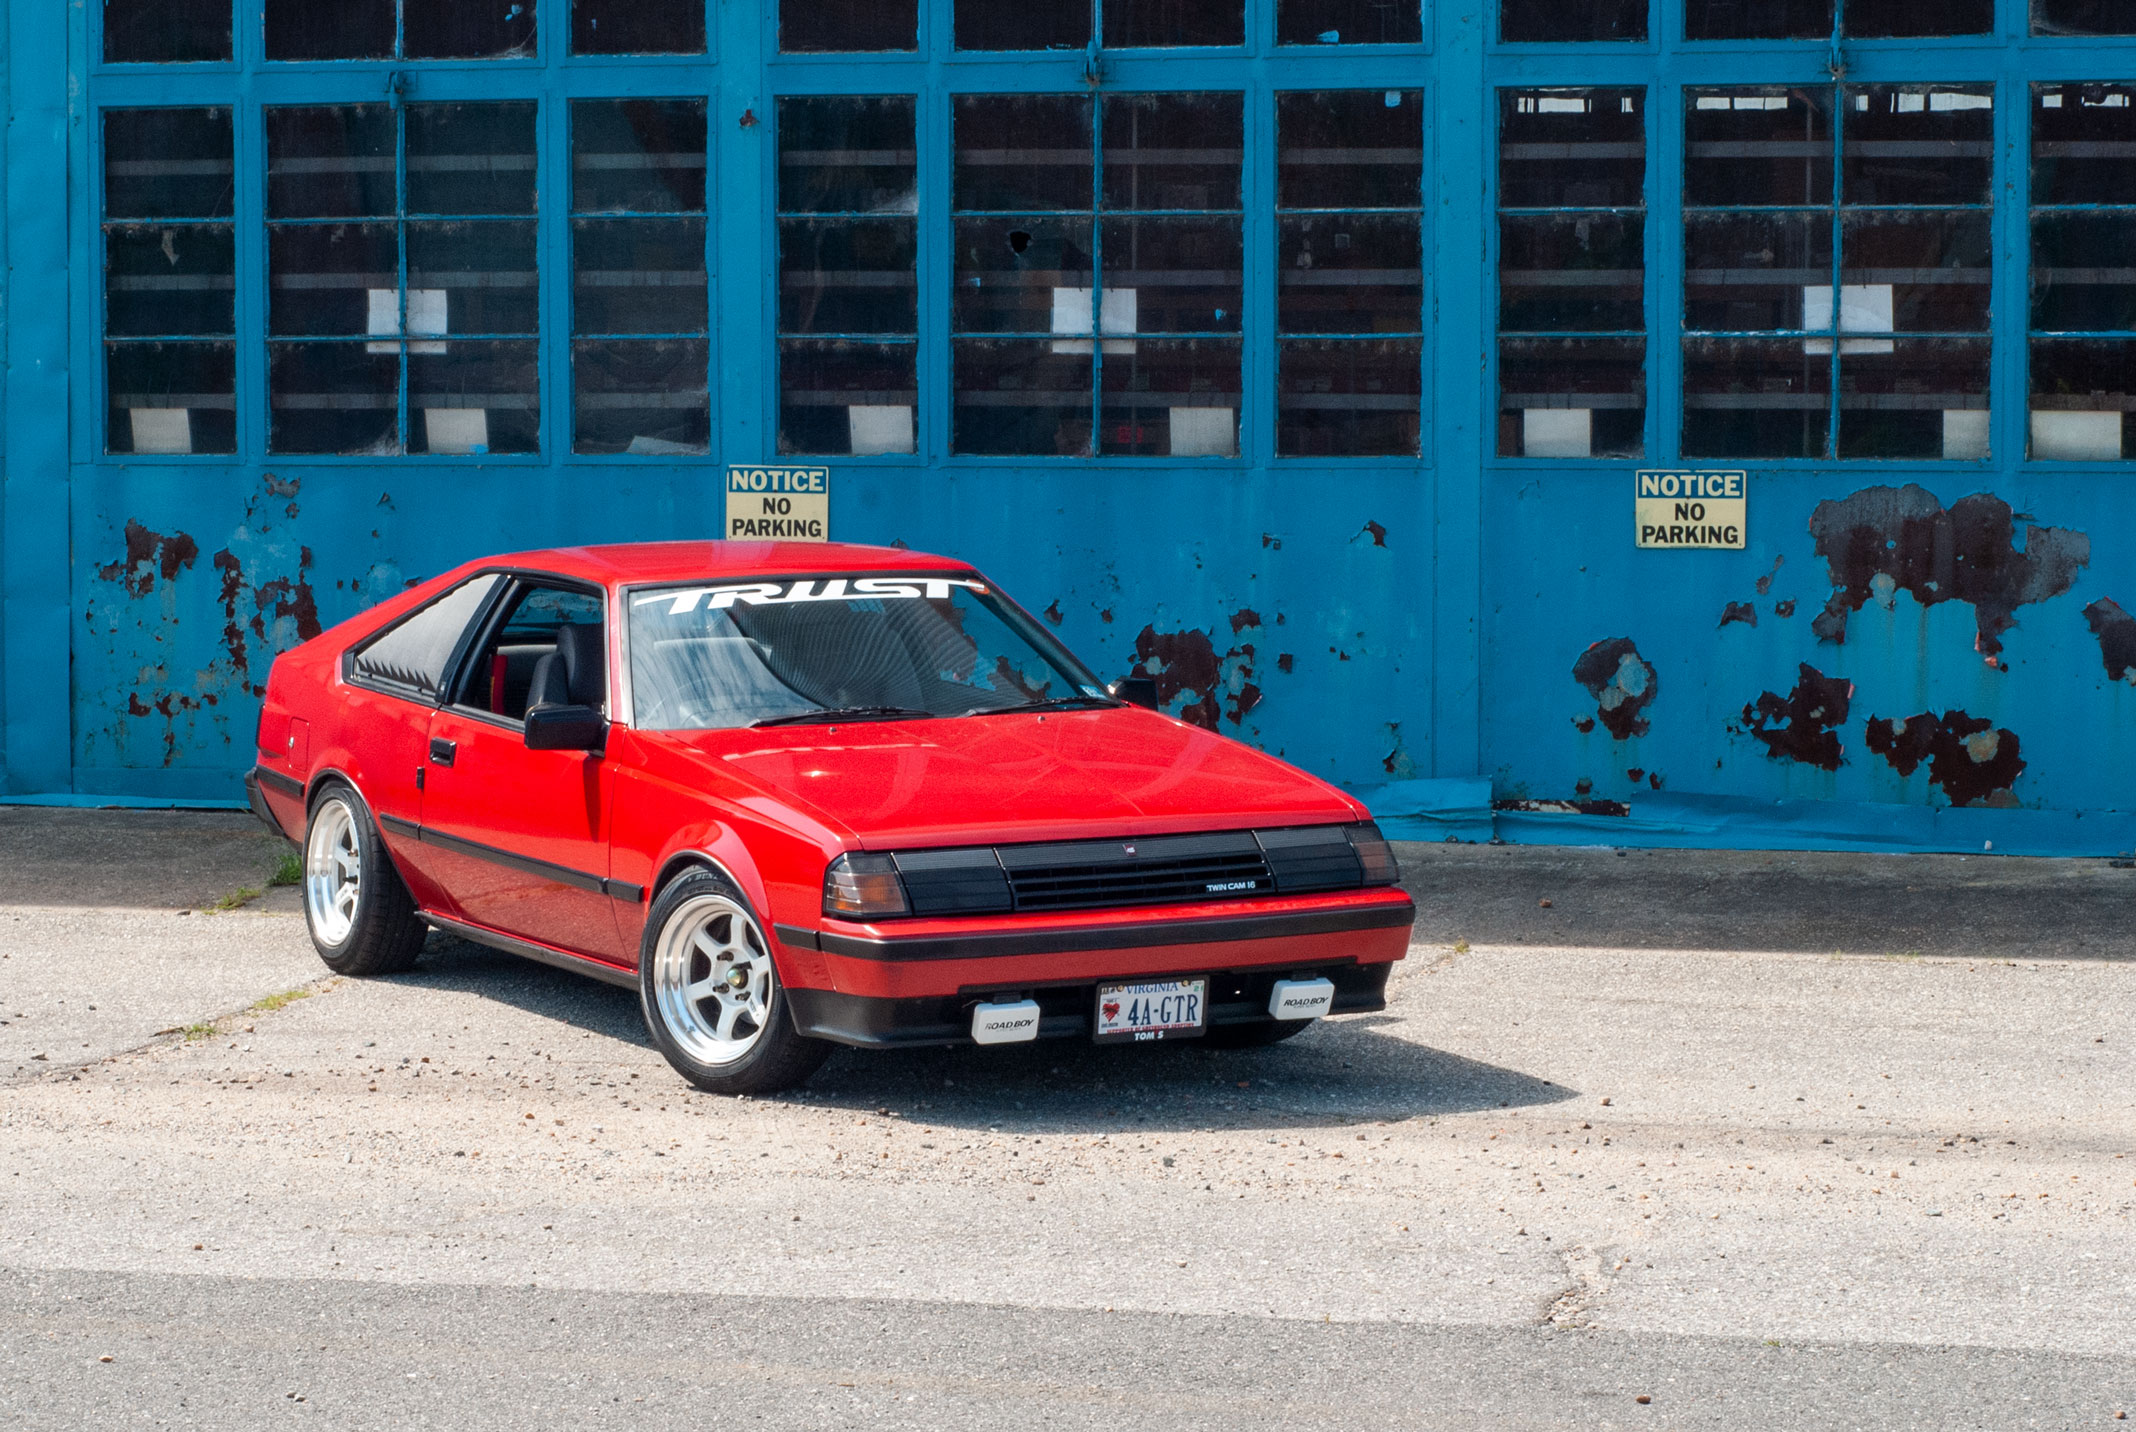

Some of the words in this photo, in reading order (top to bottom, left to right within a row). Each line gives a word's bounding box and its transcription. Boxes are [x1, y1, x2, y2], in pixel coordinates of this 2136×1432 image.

[732, 470, 824, 491] NOTICE
[1641, 475, 1740, 496] NOTICE
[763, 498, 791, 515] NO
[1675, 503, 1705, 521] NO
[732, 518, 822, 537] PARKING
[1642, 525, 1739, 544] PARKING
[634, 578, 984, 615] TRUST
[1247, 881, 1256, 889] 16
[1126, 983, 1178, 994] VIRGINIA
[1127, 994, 1198, 1026] 4A-GTR
[985, 1022, 1014, 1030] ROAD
[1014, 1019, 1034, 1028] BOY
